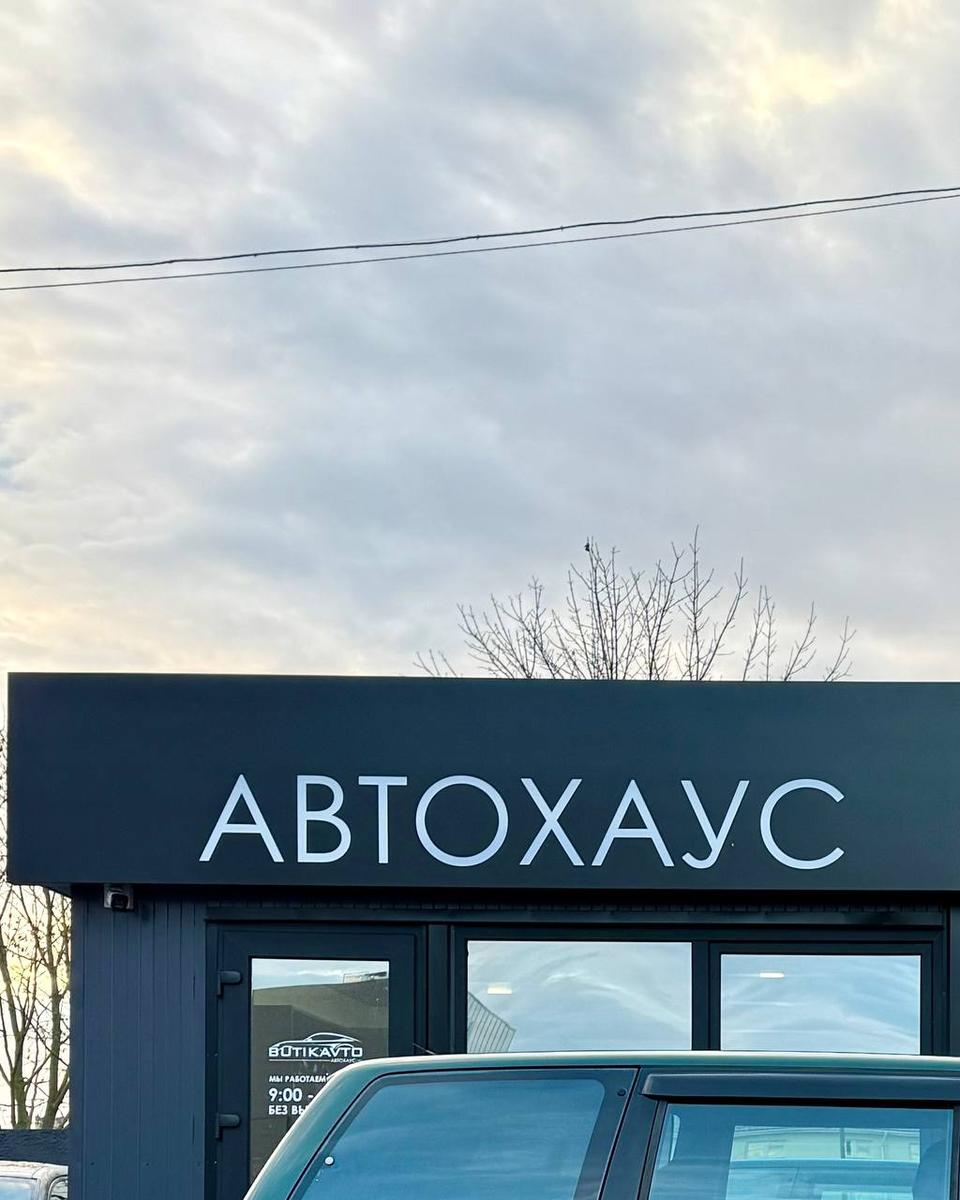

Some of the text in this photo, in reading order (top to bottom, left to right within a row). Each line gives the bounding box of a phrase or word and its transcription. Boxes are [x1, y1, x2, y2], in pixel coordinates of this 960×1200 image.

[199, 774, 845, 870] АВТОХАУС
[268, 1047, 363, 1057] BUTIKAVTO
[268, 1088, 302, 1101] 9:00
[268, 1105, 288, 1115] БЕЗ
